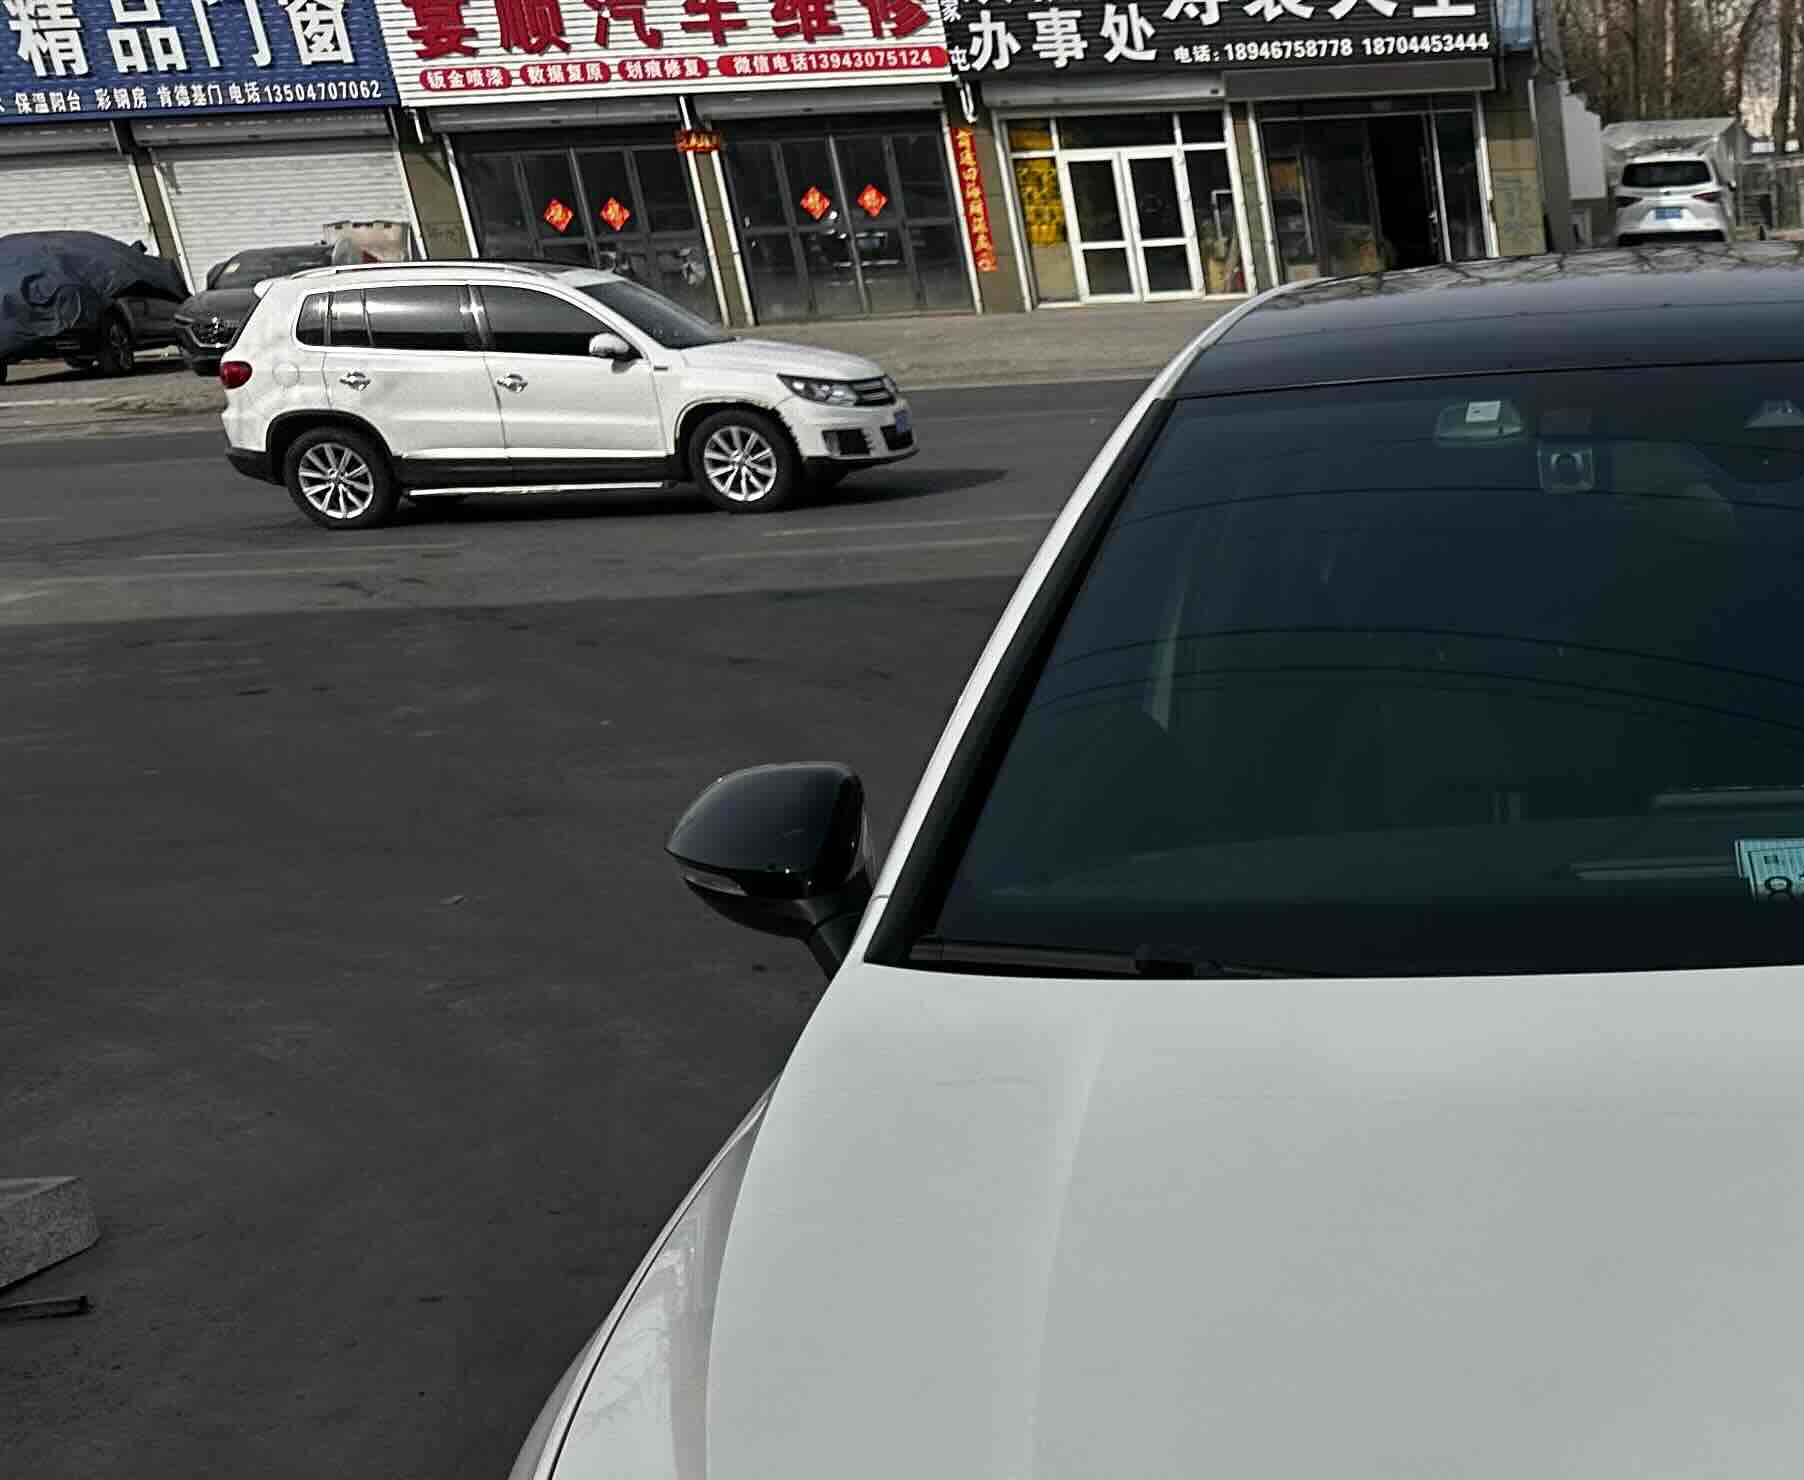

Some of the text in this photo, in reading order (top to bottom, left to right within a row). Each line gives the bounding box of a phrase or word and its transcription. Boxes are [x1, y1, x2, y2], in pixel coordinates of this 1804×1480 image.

[2, 0, 355, 77] 精品门窗
[968, 2, 1158, 72] 办事处
[1361, 31, 1490, 57] 18704453444
[426, 68, 505, 90] 钣金喷漆
[625, 57, 702, 80] 划痕修复
